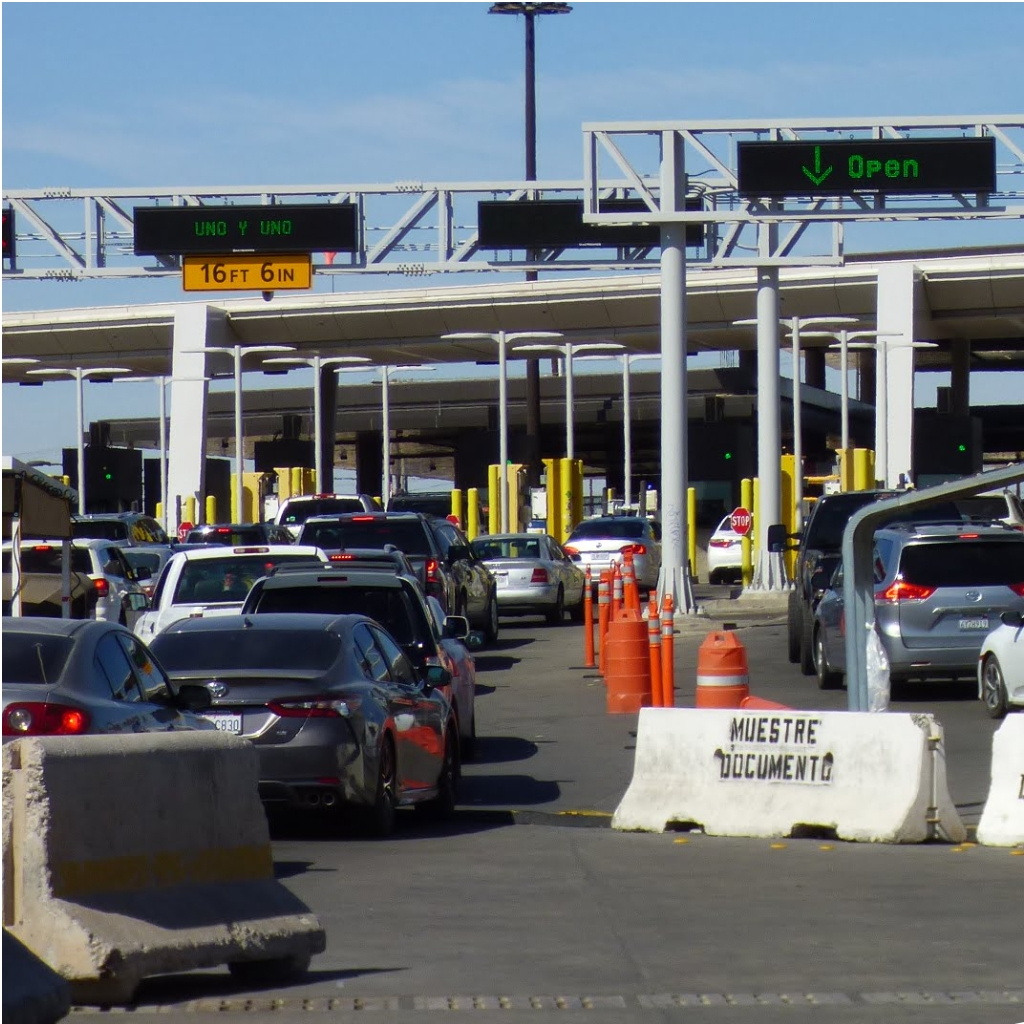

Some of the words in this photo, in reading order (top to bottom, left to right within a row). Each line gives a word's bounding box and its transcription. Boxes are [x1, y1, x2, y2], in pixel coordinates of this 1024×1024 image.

[848, 154, 919, 179] Open
[194, 221, 227, 236] UNO
[238, 221, 248, 236] Y
[260, 220, 292, 235] UNO
[732, 515, 750, 527] STOP
[730, 717, 819, 744] MUESTRE
[720, 753, 833, 782] DOCUMENTO
